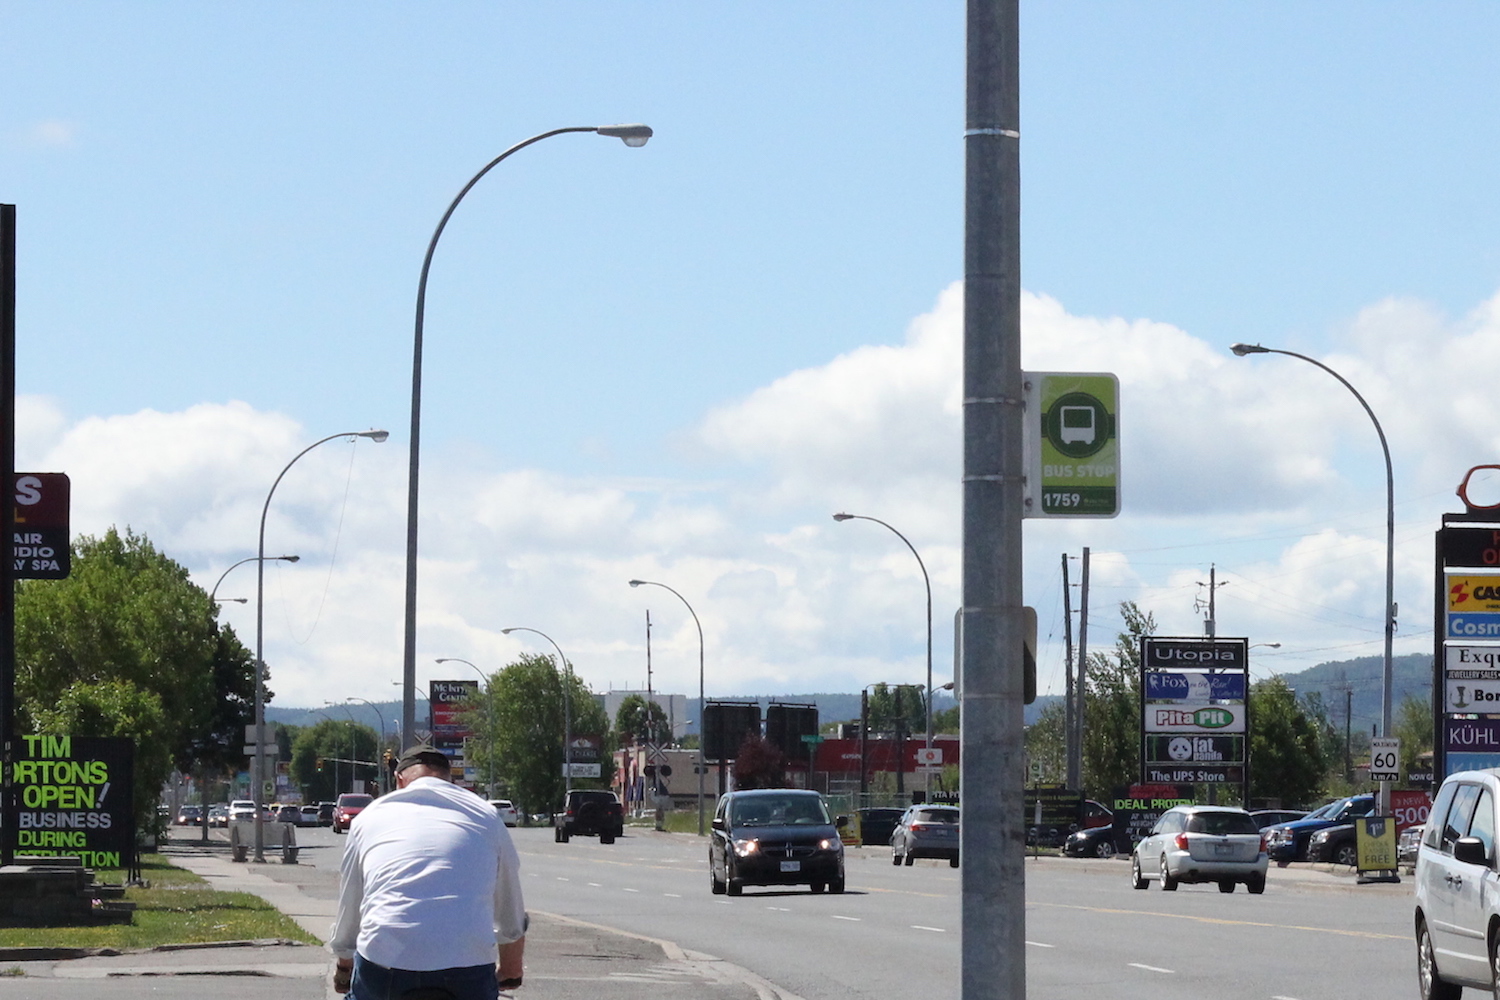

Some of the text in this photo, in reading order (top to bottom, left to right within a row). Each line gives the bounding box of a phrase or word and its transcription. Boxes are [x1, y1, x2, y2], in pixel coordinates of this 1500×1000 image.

[1043, 464, 1115, 478] BUS STOP
[15, 476, 42, 505] S
[1044, 493, 1080, 507] 1759
[14, 533, 42, 544] AIR
[32, 560, 60, 571] SPA
[1155, 648, 1236, 662] Utopia
[1161, 675, 1187, 688] Fox
[1448, 671, 1480, 680] JEWELLERY
[1481, 671, 1498, 680] SALES
[1156, 709, 1226, 726] Pita Pit
[1450, 725, 1499, 745] KÜHL
[22, 735, 71, 758] TIM
[1193, 737, 1214, 752] fat
[1193, 752, 1222, 762] panda
[1374, 752, 1396, 768] 60
[1151, 770, 1225, 782] The UPS Store
[1373, 773, 1398, 781] km/h
[22, 782, 111, 809] OPEN!
[1114, 799, 1148, 810] IDEAL
[19, 812, 112, 829] BUSINESS
[1390, 805, 1430, 825] 500
[18, 830, 87, 848] DURING
[1364, 854, 1390, 865] FREE
